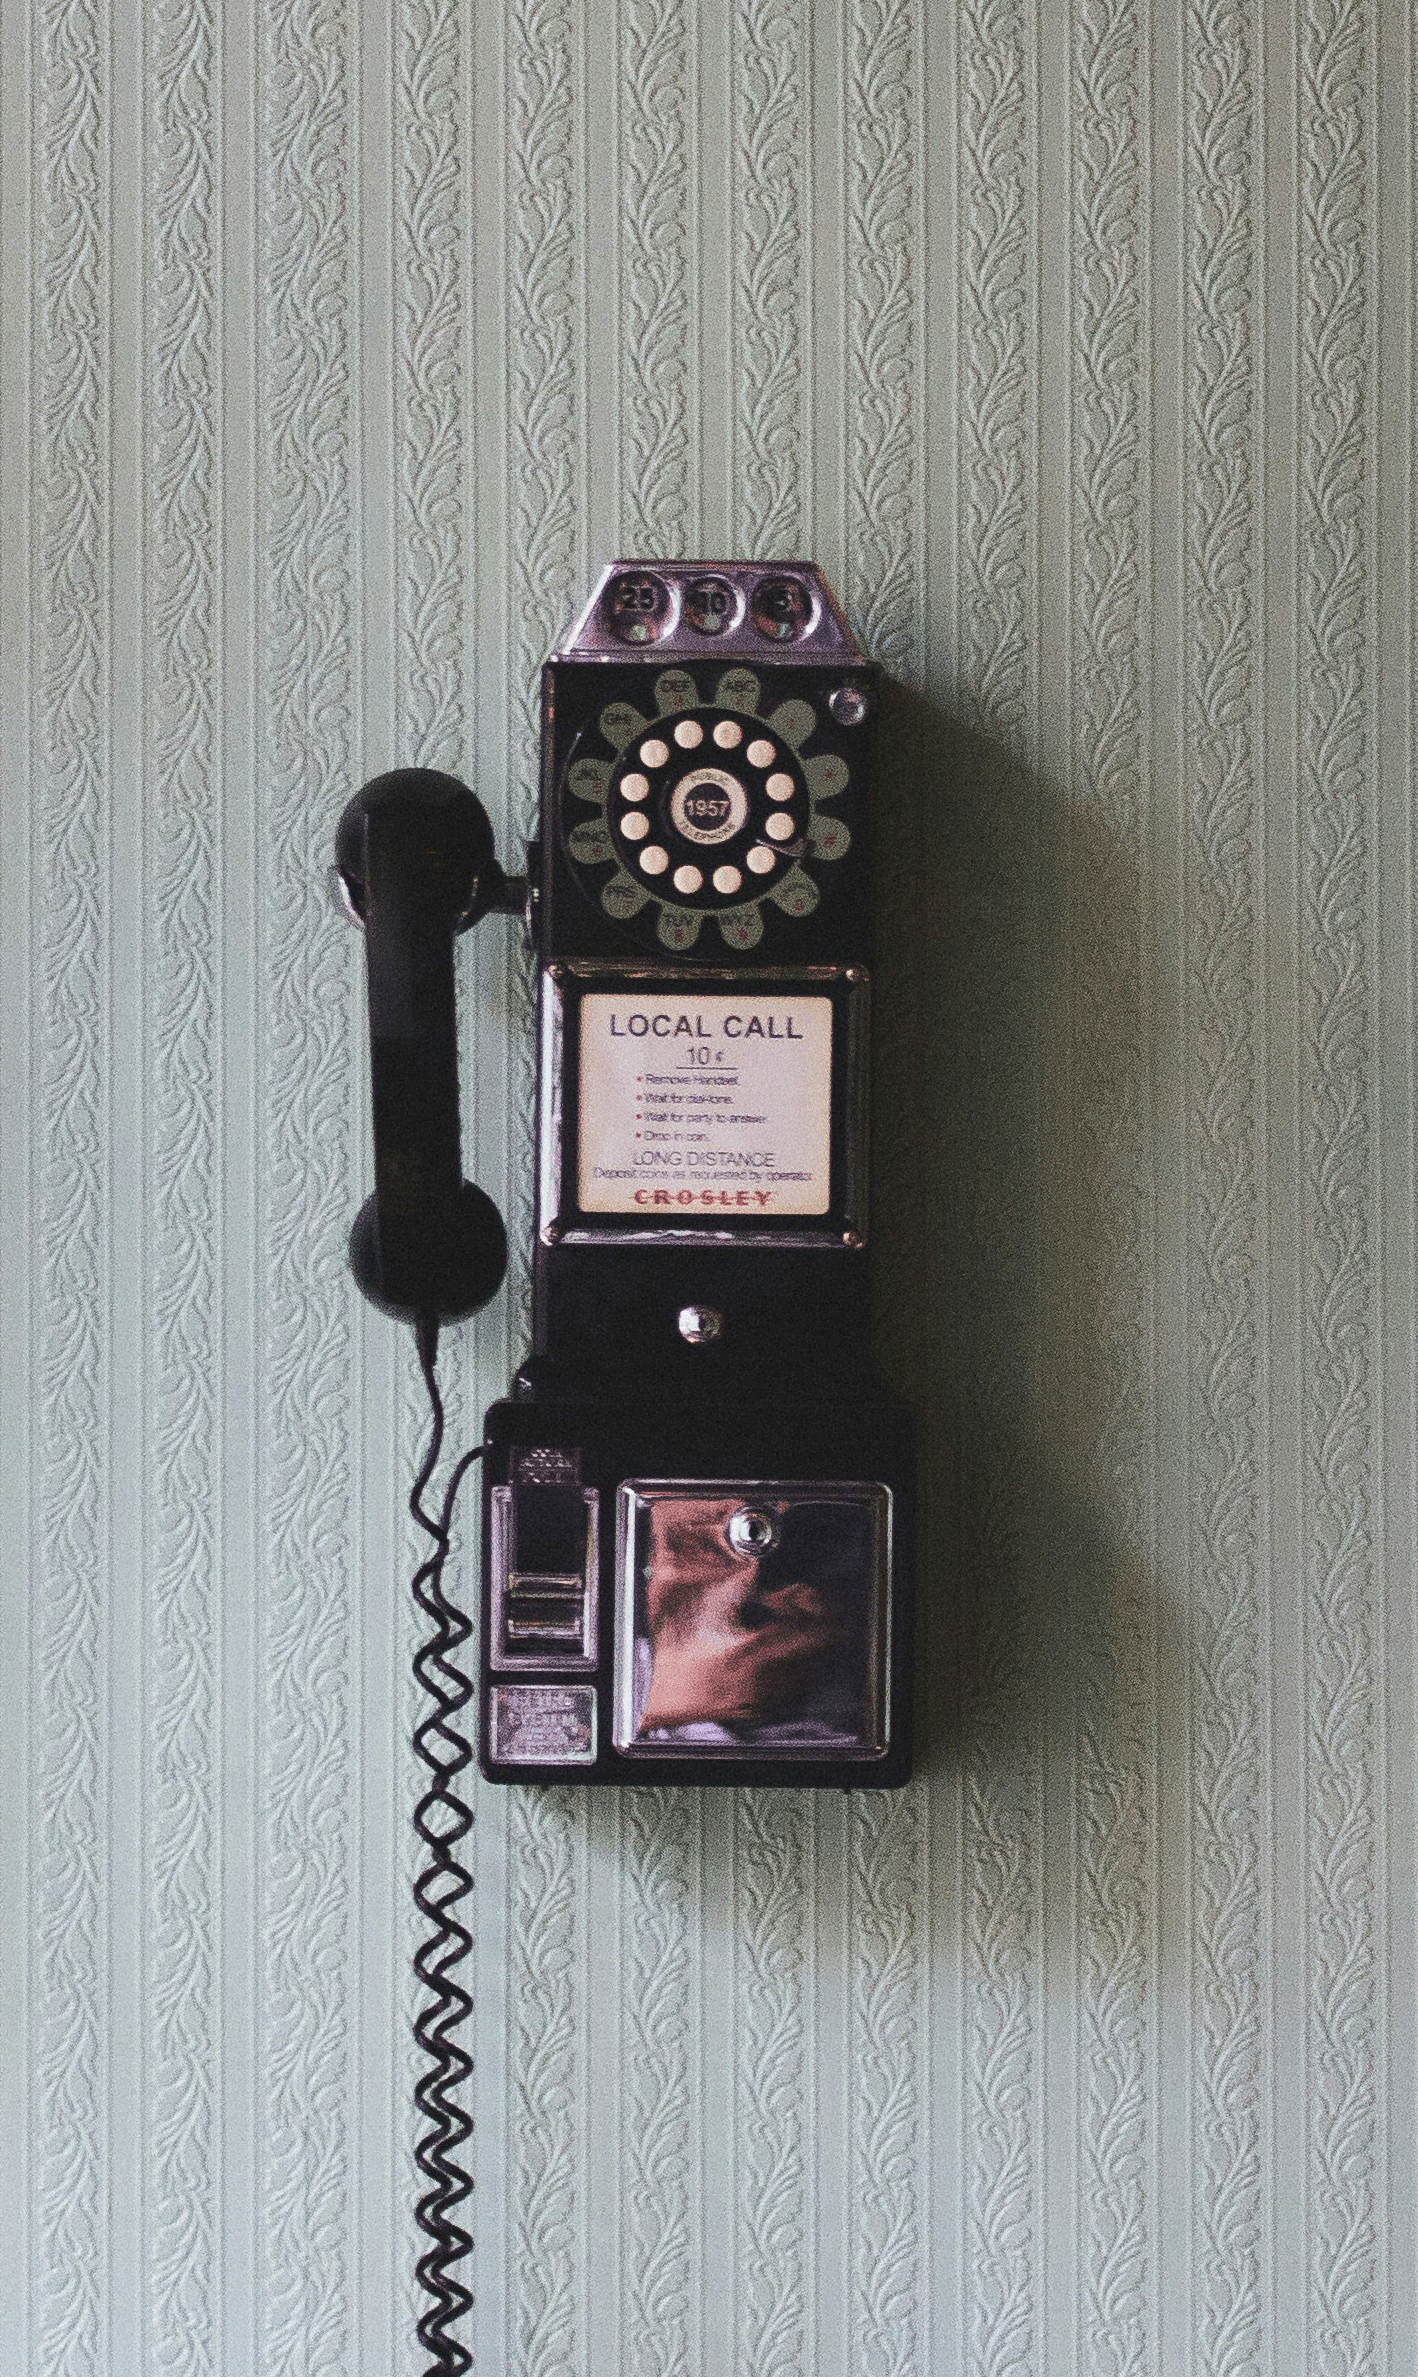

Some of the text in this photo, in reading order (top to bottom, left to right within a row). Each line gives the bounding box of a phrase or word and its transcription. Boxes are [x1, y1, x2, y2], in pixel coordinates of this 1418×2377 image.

[622, 585, 657, 611] 25
[660, 680, 690, 693] DEF
[724, 680, 756, 693] ABC
[690, 771, 731, 786] PUBLIC
[685, 799, 730, 818] 1957
[679, 820, 735, 841] TELEPHONE
[664, 913, 695, 927] TUV
[609, 1014, 803, 1039] LOCAL CALL
[645, 1074, 690, 1085] Remove
[645, 1093, 669, 1103] Wait
[671, 1093, 683, 1103] for
[644, 1112, 669, 1123] Wait
[671, 1113, 683, 1123] for
[687, 1113, 713, 1125] party
[715, 1113, 727, 1124] to
[644, 1131, 671, 1142] Drop
[674, 1131, 683, 1142] in
[632, 1151, 776, 1168] LONG DISTANCE
[593, 1167, 639, 1180] Deposit
[633, 1189, 772, 1206] CROSLEY
